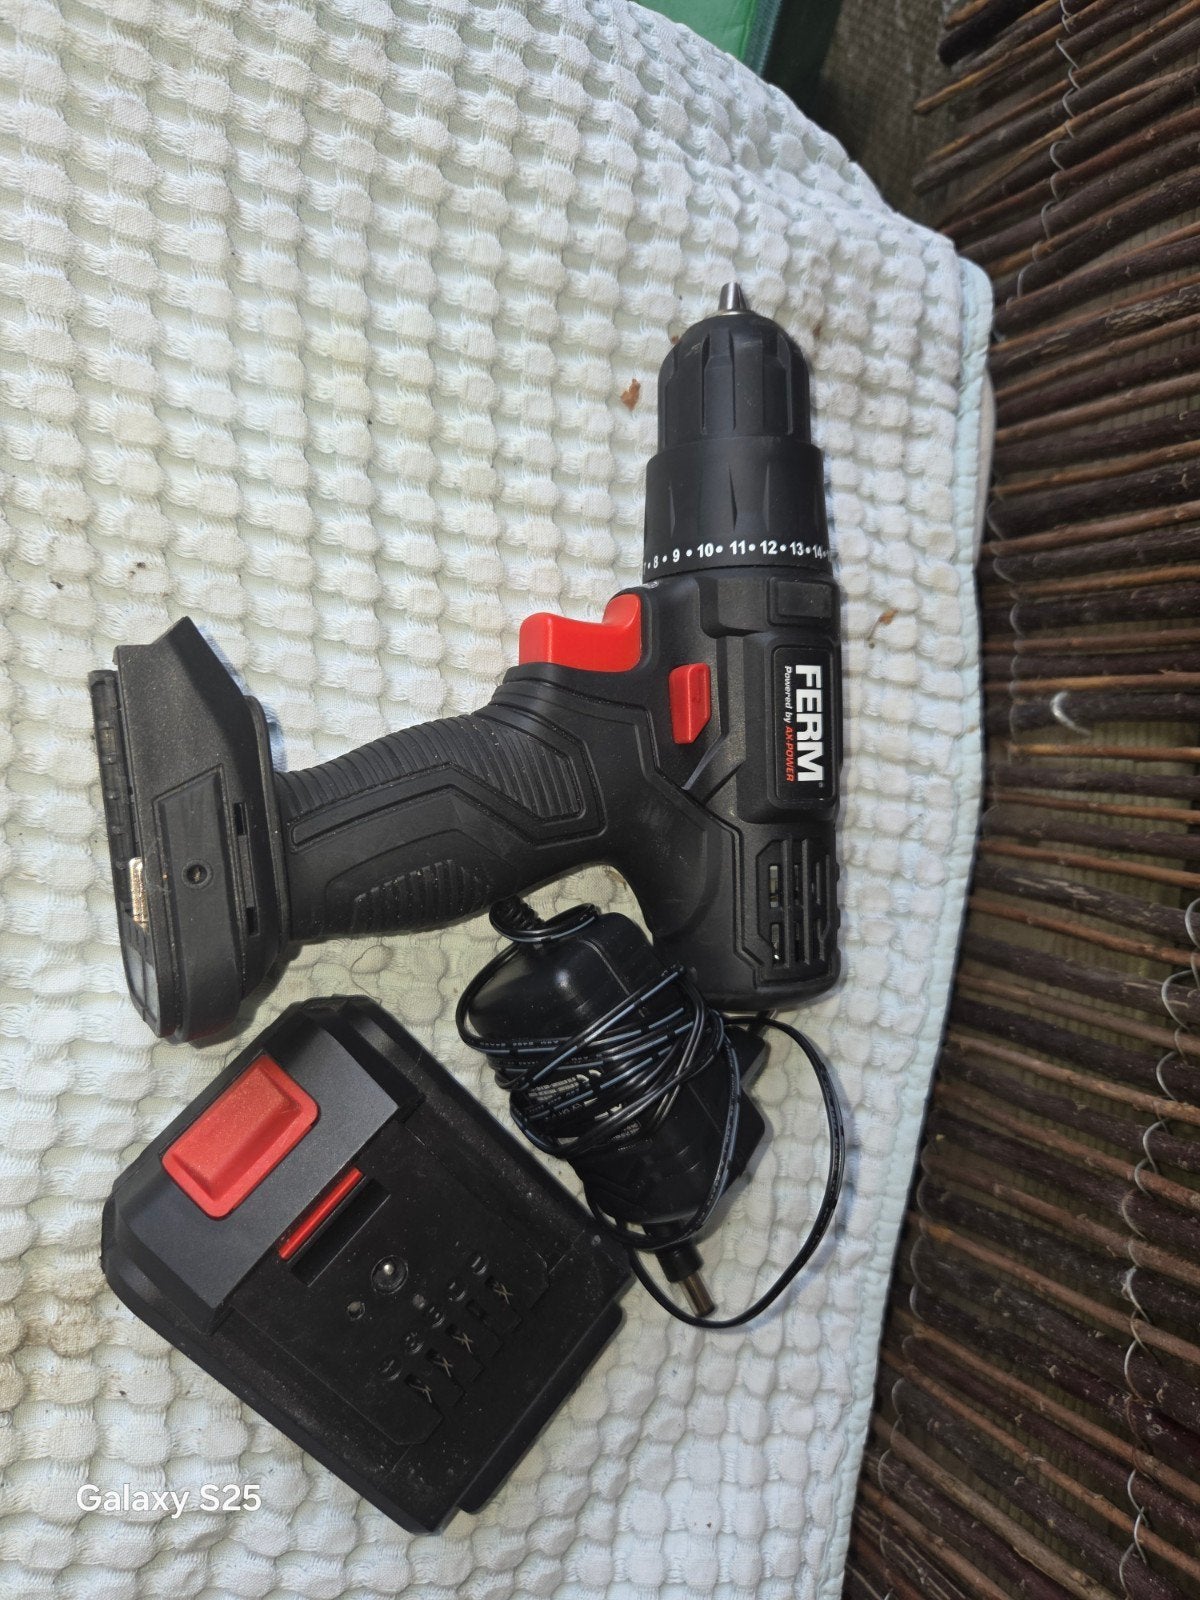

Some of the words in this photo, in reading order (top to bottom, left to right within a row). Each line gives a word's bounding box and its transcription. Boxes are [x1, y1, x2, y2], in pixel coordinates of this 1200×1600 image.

[653, 555, 659, 569] 8
[672, 548, 680, 563] 9
[697, 543, 714, 558] 10
[729, 540, 746, 555] 11
[759, 540, 777, 555] 12
[789, 541, 804, 556] 13
[812, 544, 823, 559] 14
[784, 665, 794, 709] Powered
[783, 711, 793, 723] by
[795, 664, 824, 782] FERM
[785, 726, 794, 782] AX-POWER
